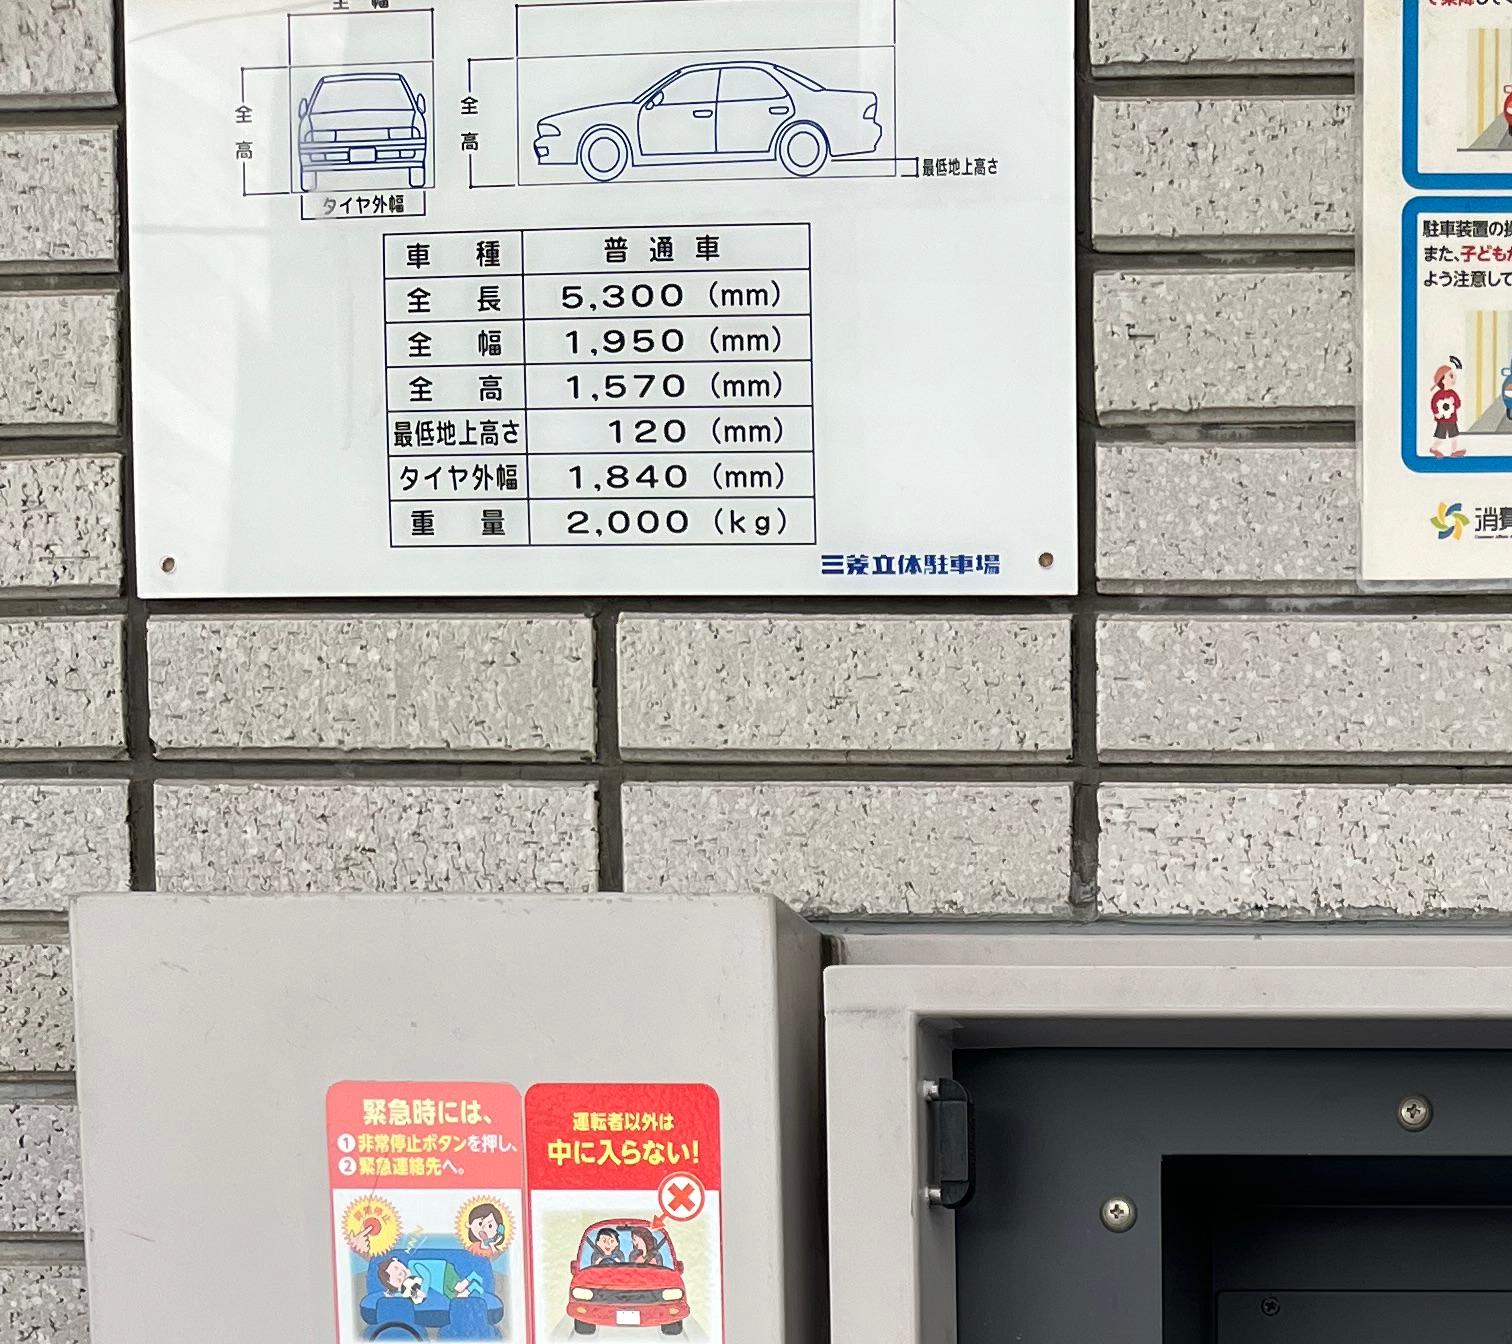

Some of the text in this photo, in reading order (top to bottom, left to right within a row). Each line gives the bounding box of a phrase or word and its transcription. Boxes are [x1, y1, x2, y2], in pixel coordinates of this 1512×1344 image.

[235, 105, 254, 160] 全高
[460, 96, 479, 151] 全高
[922, 157, 999, 177] 最低地上高さ
[322, 194, 406, 216] タイヤ外幅
[561, 284, 684, 311] 5,300
[565, 329, 684, 357] 1,950
[566, 374, 686, 402] 1,570
[393, 419, 520, 448] 最低地上高さ
[608, 420, 687, 444] 120
[399, 463, 518, 492] タイヤ外幅
[568, 465, 688, 493] 1,840
[566, 510, 689, 537] 2,000
[821, 554, 1001, 576] 三菱立体駐車場
[363, 1099, 492, 1126] 緊急時には、
[572, 1112, 675, 1132] 運転者以外は
